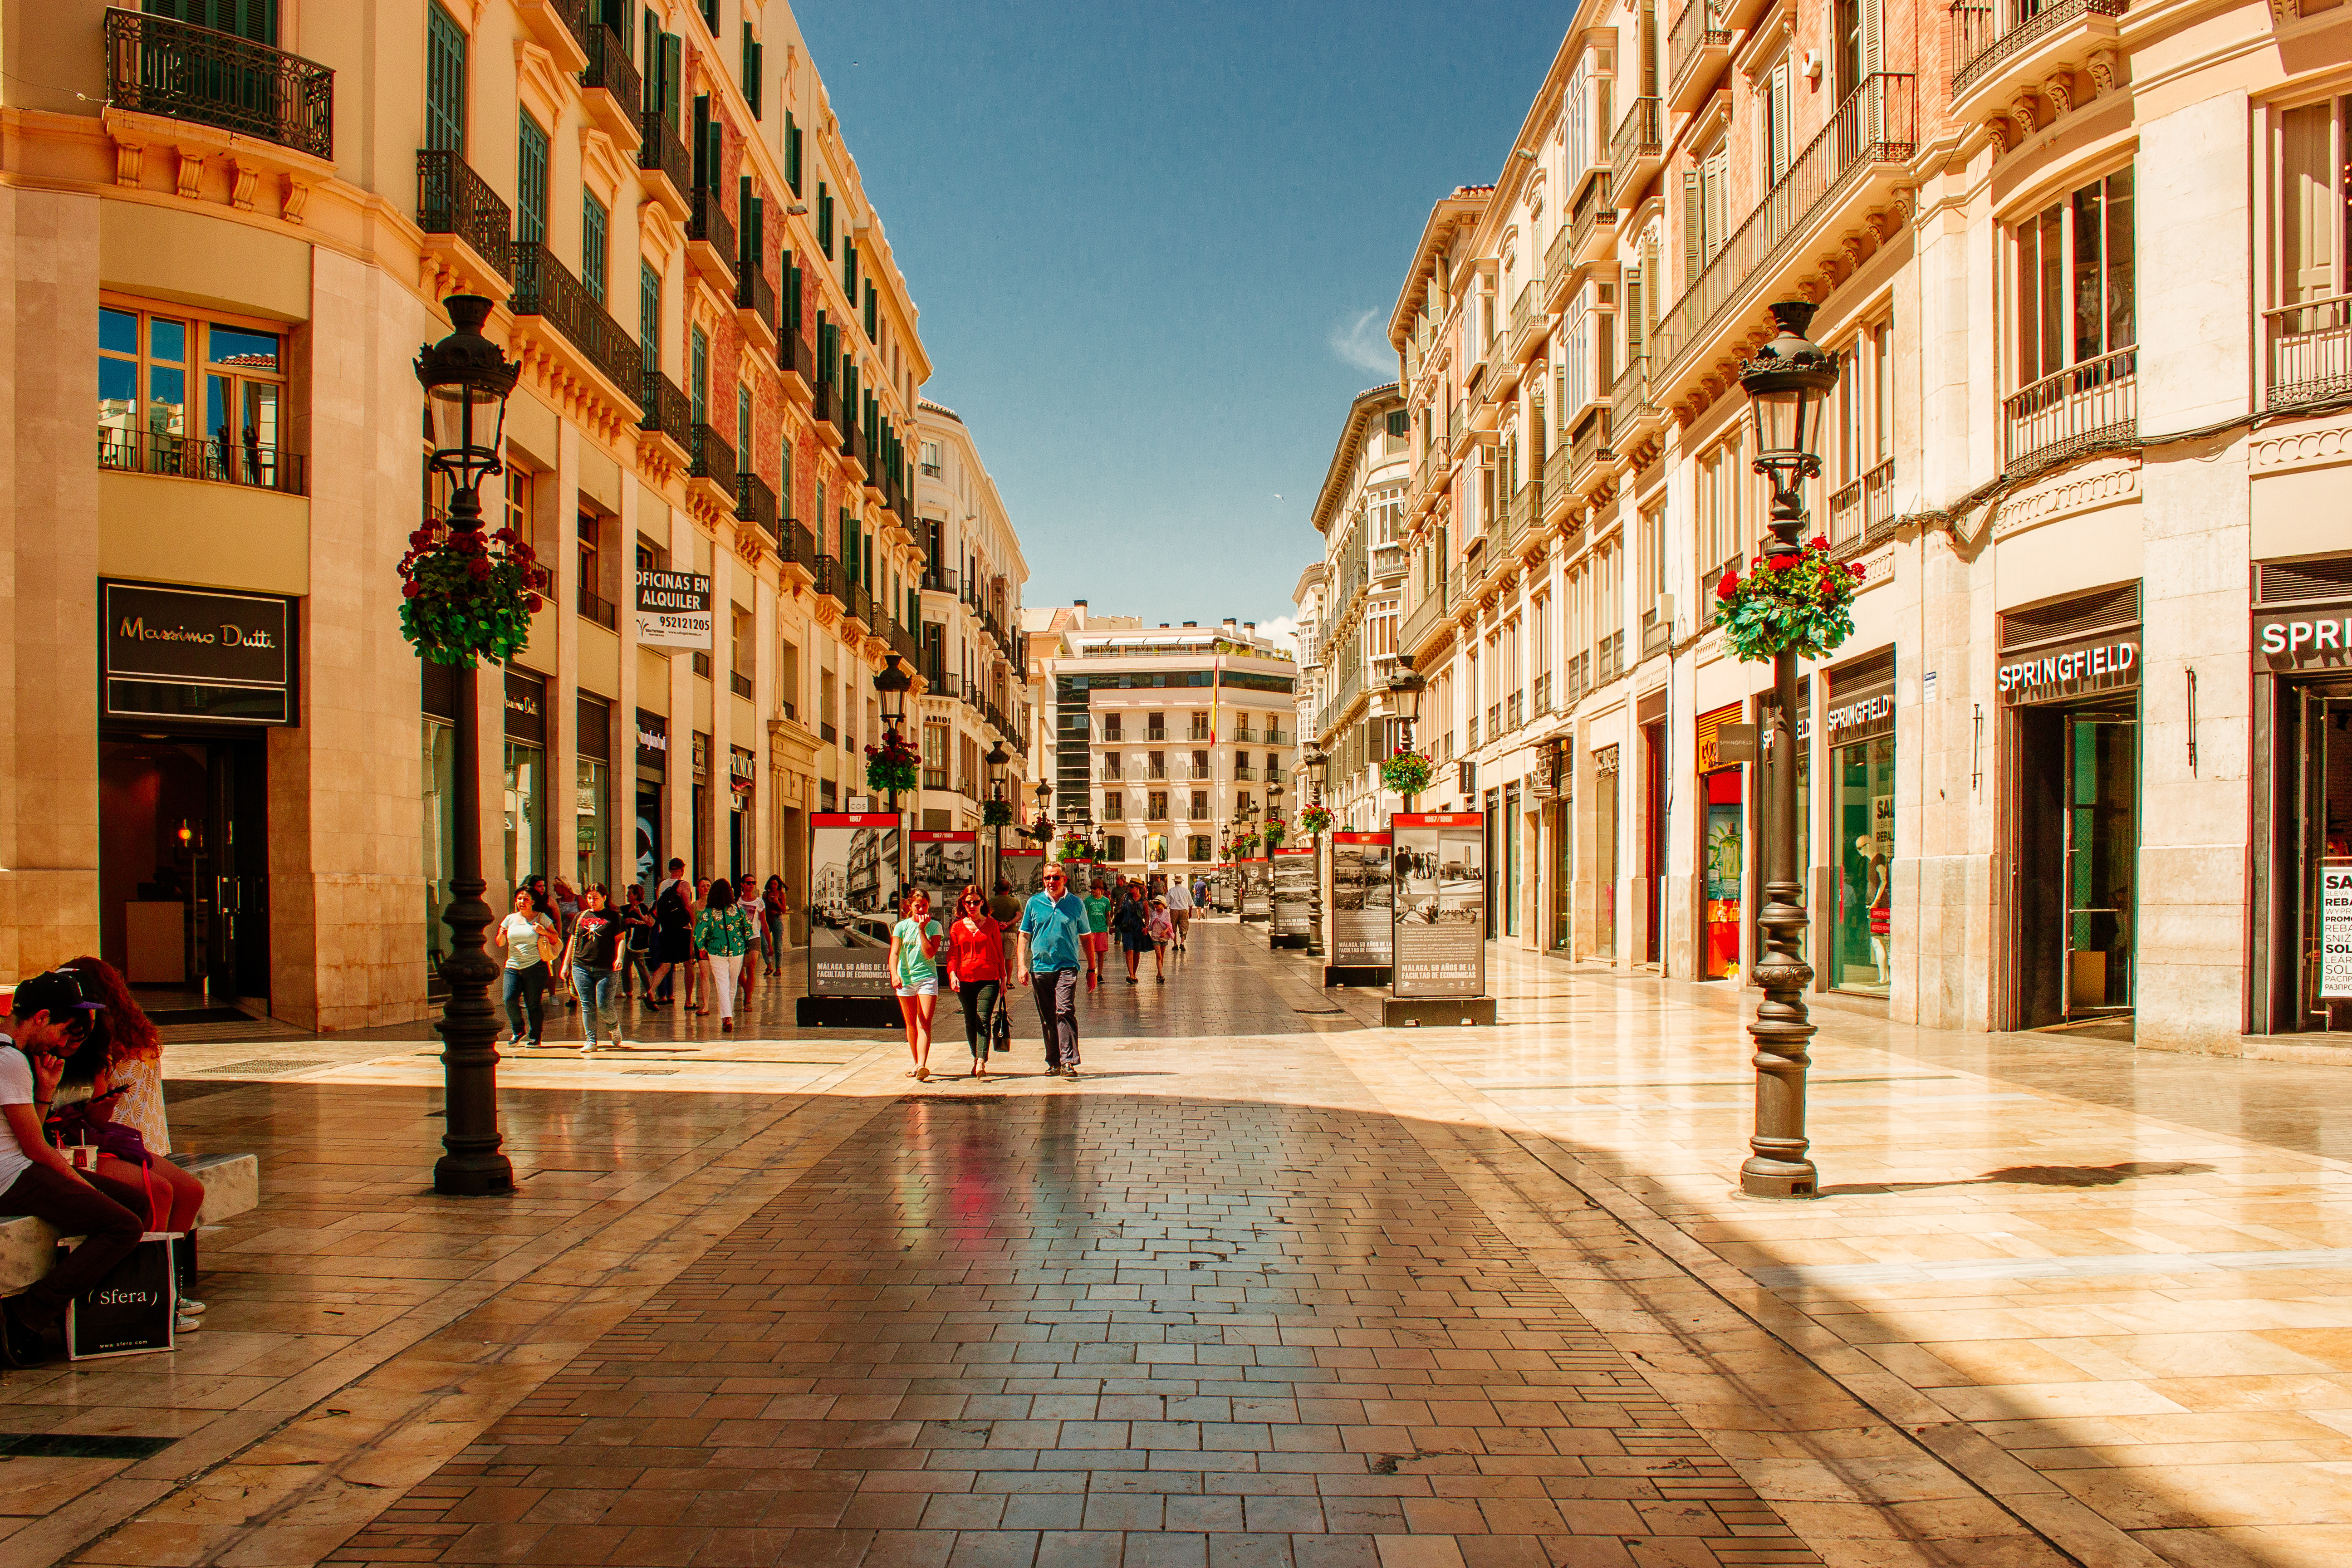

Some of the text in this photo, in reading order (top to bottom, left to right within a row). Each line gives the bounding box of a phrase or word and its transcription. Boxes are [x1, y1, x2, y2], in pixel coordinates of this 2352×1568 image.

[636, 571, 710, 593] OFICINAS EN
[642, 590, 701, 610] ALQUILER
[659, 616, 710, 631] 952121205
[120, 617, 276, 648] Massimo Dutti
[2260, 619, 2352, 654] SPRI
[1998, 642, 2135, 692] SPRINGFIELD
[1828, 695, 1891, 732] SPRINGFIELD
[2326, 944, 2352, 953] SOL
[817, 962, 845, 970] MÁLAGA,
[856, 962, 872, 970] AÑOS
[1401, 964, 1430, 972] MÁLAGA,
[1441, 963, 1457, 971] AÑOS
[2326, 965, 2352, 974] SOL
[100, 1289, 147, 1306] Sfera
[99, 1340, 147, 1349] www.sfera.com
